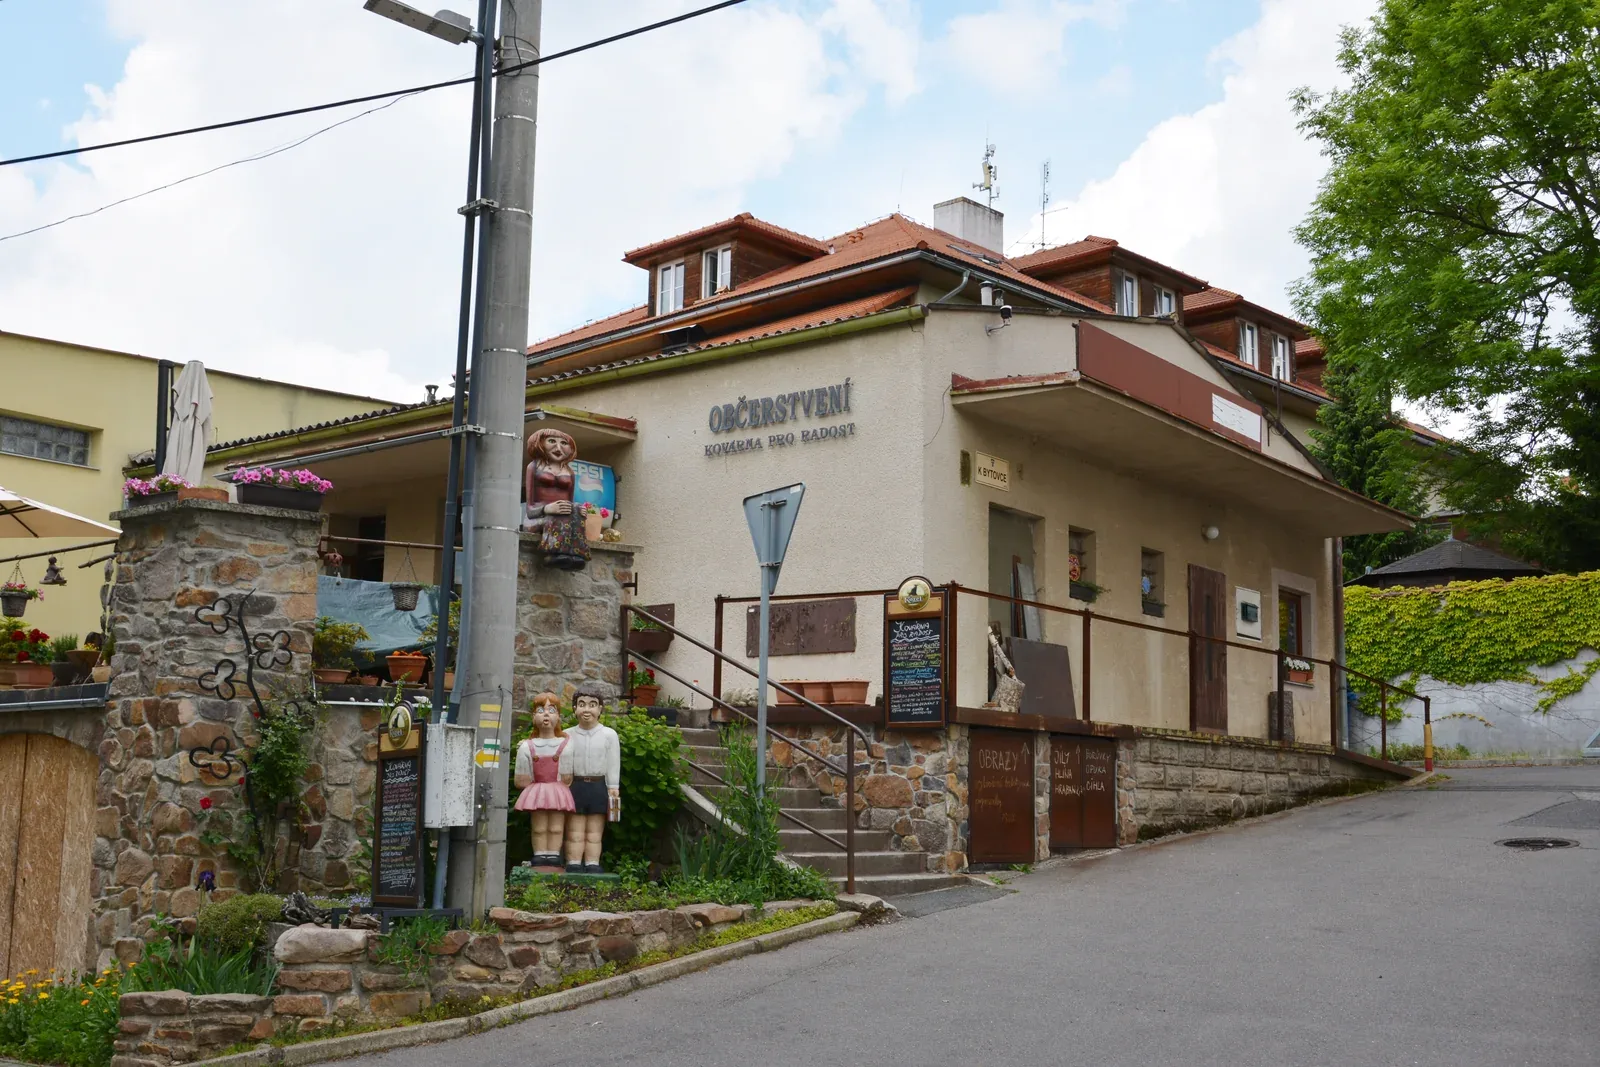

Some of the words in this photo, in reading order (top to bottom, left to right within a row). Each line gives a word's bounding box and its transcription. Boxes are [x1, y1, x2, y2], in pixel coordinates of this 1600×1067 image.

[708, 377, 852, 433] OBČERSTVENÍ
[768, 432, 795, 448] PRO
[801, 422, 855, 443] RADOST
[569, 462, 604, 480] EPSI
[978, 467, 982, 476] K
[983, 468, 1006, 482] BYTOVCE
[978, 749, 1018, 771] OBRAZY
